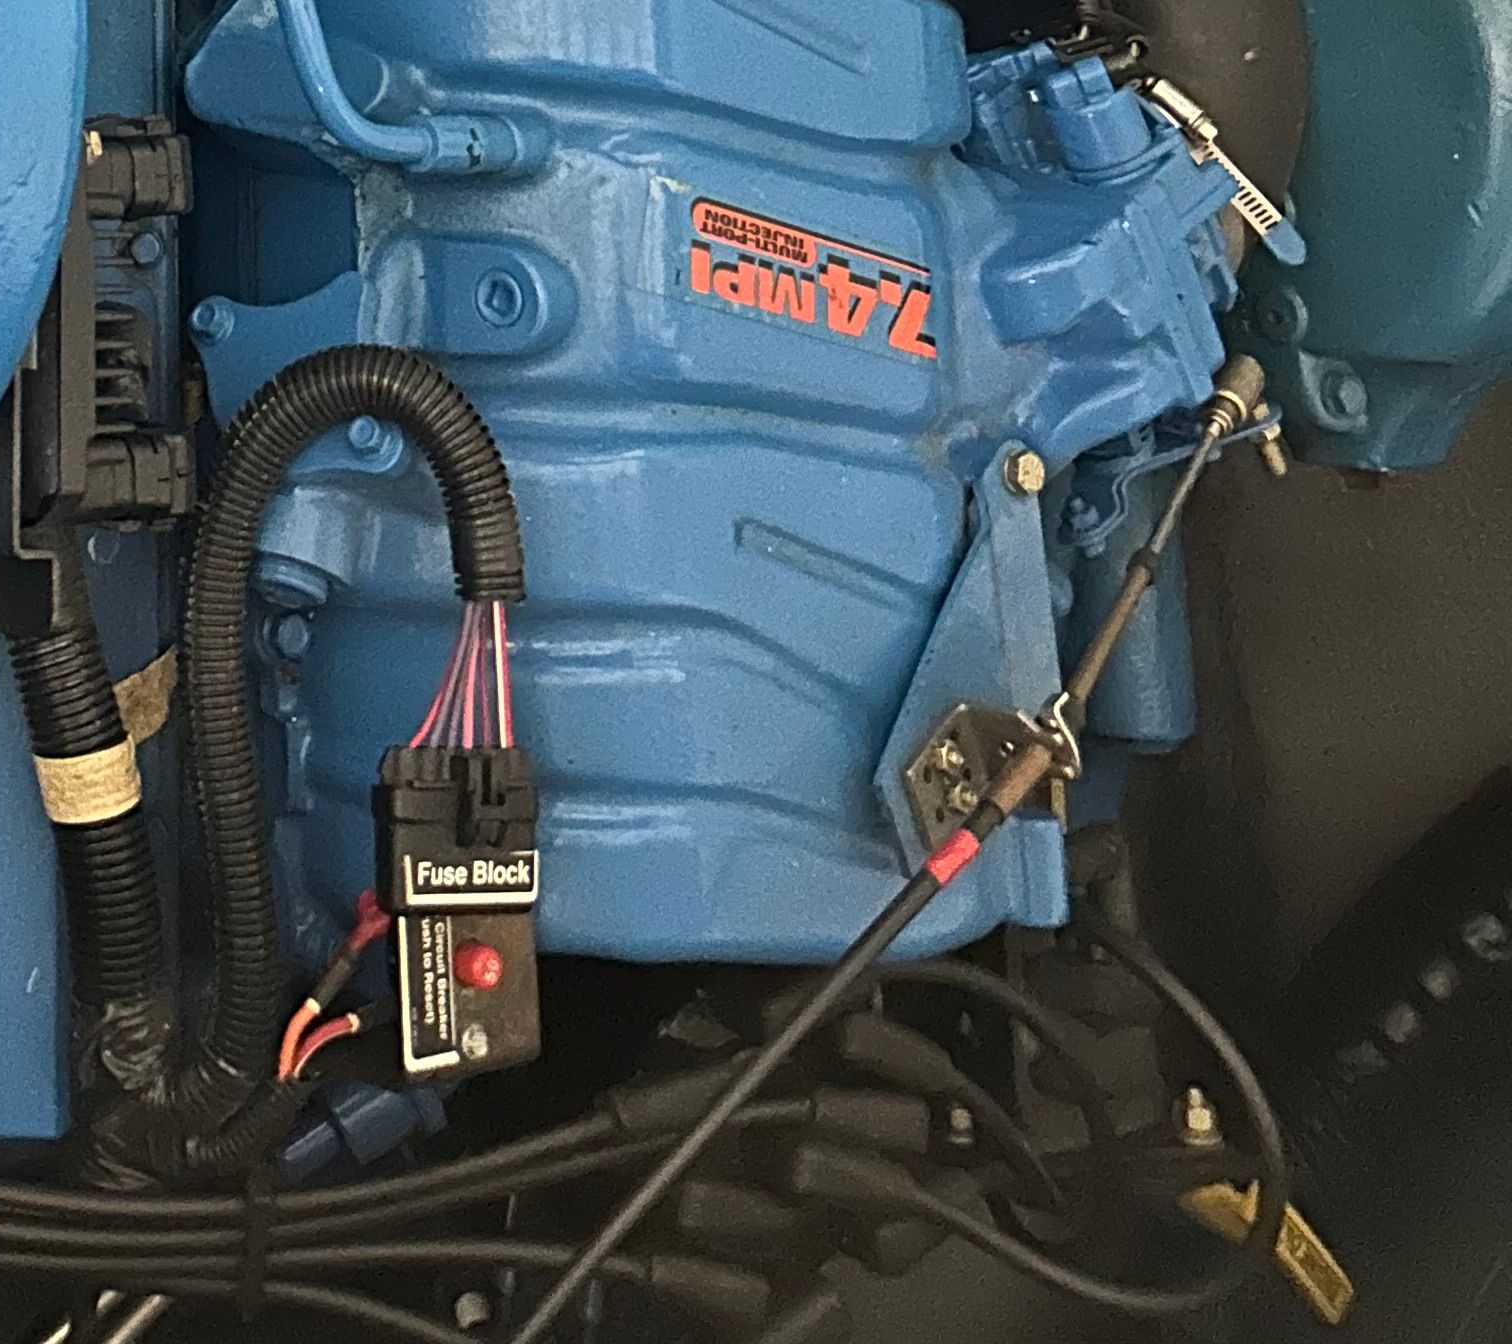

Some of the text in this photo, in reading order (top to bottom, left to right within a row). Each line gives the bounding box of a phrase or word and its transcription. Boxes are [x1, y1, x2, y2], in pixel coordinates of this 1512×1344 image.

[700, 220, 808, 263] MULTI-PORT
[703, 208, 805, 248] INJECTION
[690, 240, 937, 360] 7.4 MPI
[417, 859, 532, 886] Fuse Block
[423, 952, 433, 969] to
[434, 921, 448, 1040] Circuit Breaker
